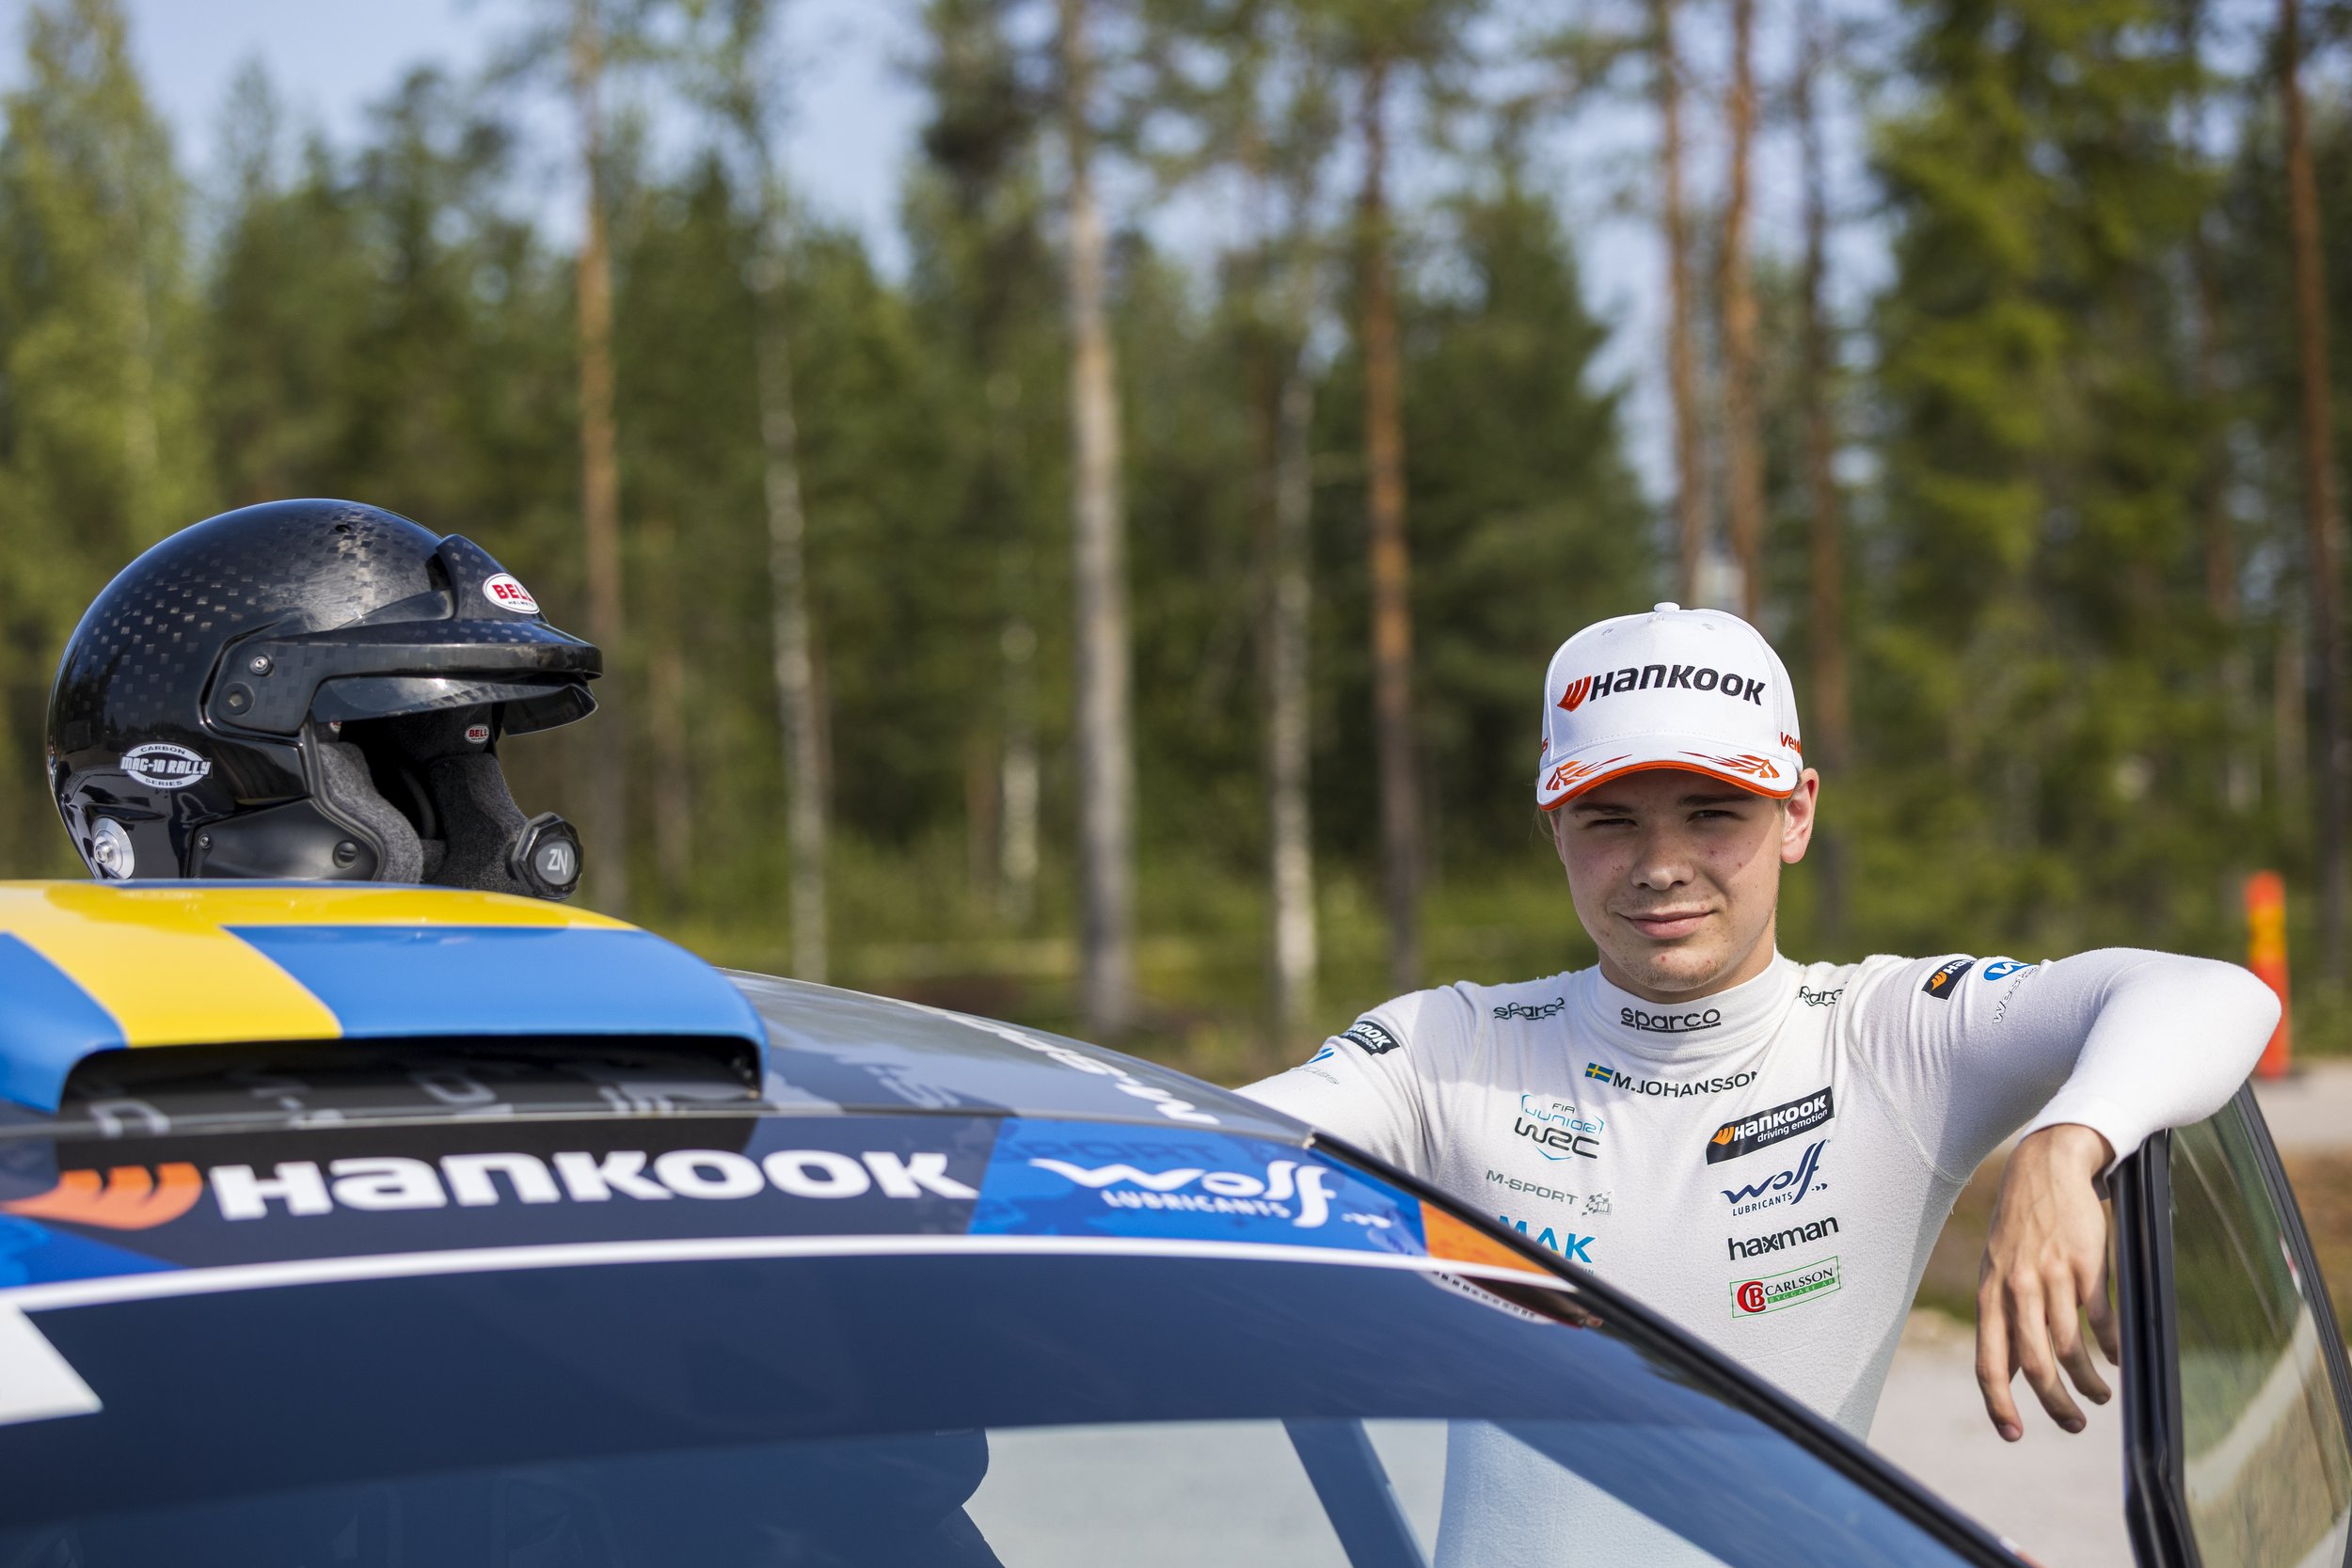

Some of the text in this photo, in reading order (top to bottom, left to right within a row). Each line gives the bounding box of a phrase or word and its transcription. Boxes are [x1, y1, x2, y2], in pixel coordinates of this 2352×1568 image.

[491, 583, 534, 603] BELL
[469, 729, 487, 737] BELL
[140, 745, 186, 755] CARBON
[120, 756, 211, 776] MAG-10 RALLY
[144, 777, 183, 787] SERIES
[547, 848, 568, 876] ZN
[1620, 1006, 1722, 1033] sparco
[1524, 1107, 1597, 1134] JUNIOR
[1551, 1102, 1576, 1115] FIA
[1514, 1116, 1600, 1160] WRC
[1756, 1108, 1828, 1144] driving emotion
[1486, 1169, 1580, 1205] M-SPORT
[1101, 1189, 1293, 1219] LUBRICANTS
[1732, 1191, 1793, 1217] LUBRICANTS
[1499, 1214, 1597, 1264] MAK
[1728, 1215, 1839, 1260] haxman
[1765, 1267, 1834, 1296] CARLSSON
